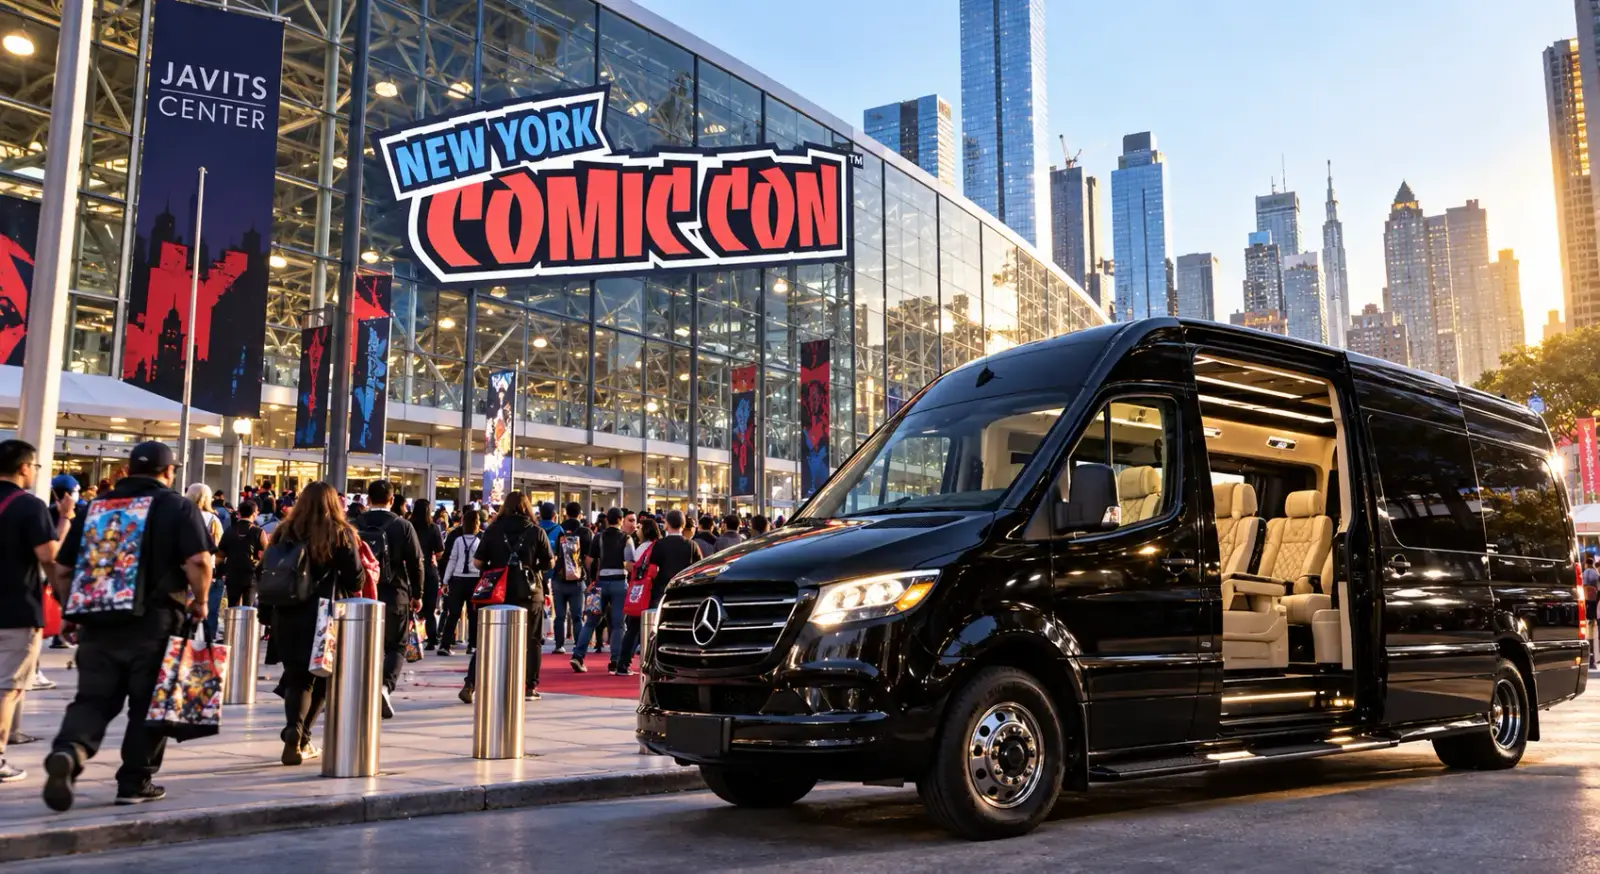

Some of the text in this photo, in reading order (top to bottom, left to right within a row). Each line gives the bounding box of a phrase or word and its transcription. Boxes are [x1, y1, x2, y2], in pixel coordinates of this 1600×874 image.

[160, 61, 267, 100] JAVITS
[158, 95, 265, 130] CENTER
[395, 106, 598, 187] NEW YORK
[427, 164, 838, 267] COMIC CON
